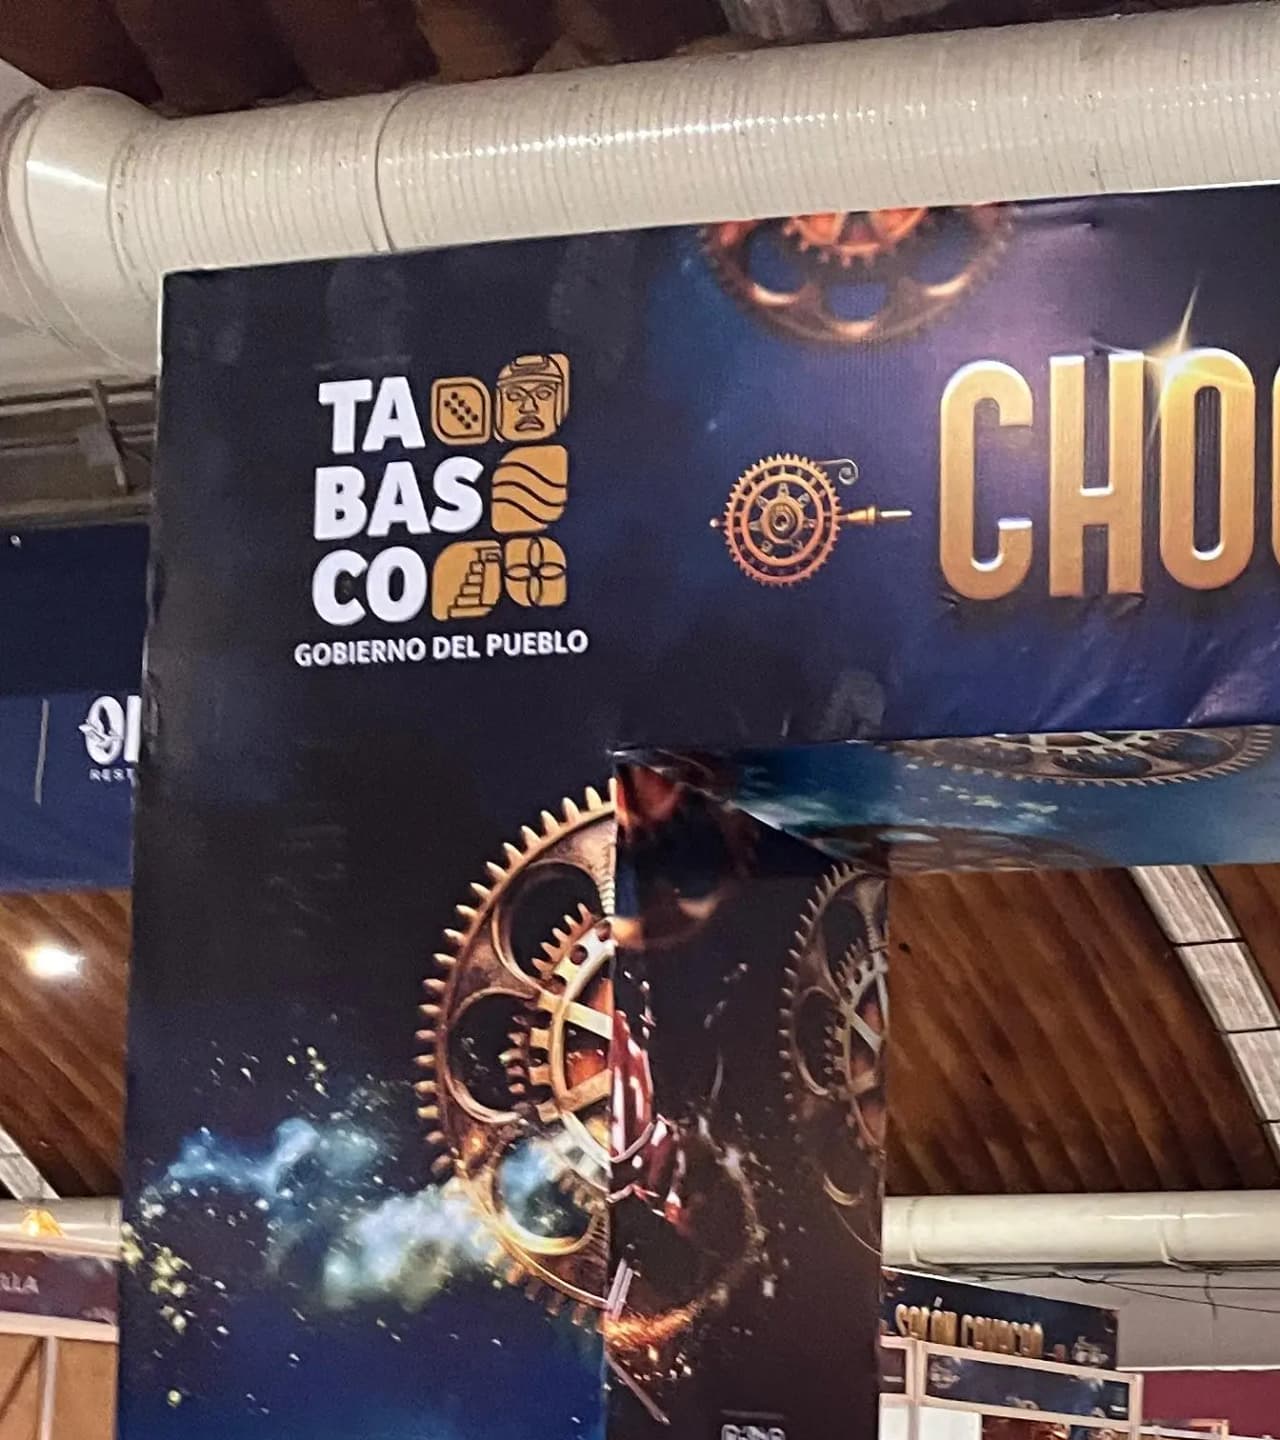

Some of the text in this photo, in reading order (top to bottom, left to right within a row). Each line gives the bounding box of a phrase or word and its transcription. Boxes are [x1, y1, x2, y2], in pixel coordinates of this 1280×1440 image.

[317, 375, 427, 455] TA
[313, 455, 485, 541] BAS
[311, 545, 429, 627] CO
[293, 628, 590, 667] GOBIERNO DEL PUEBLO
